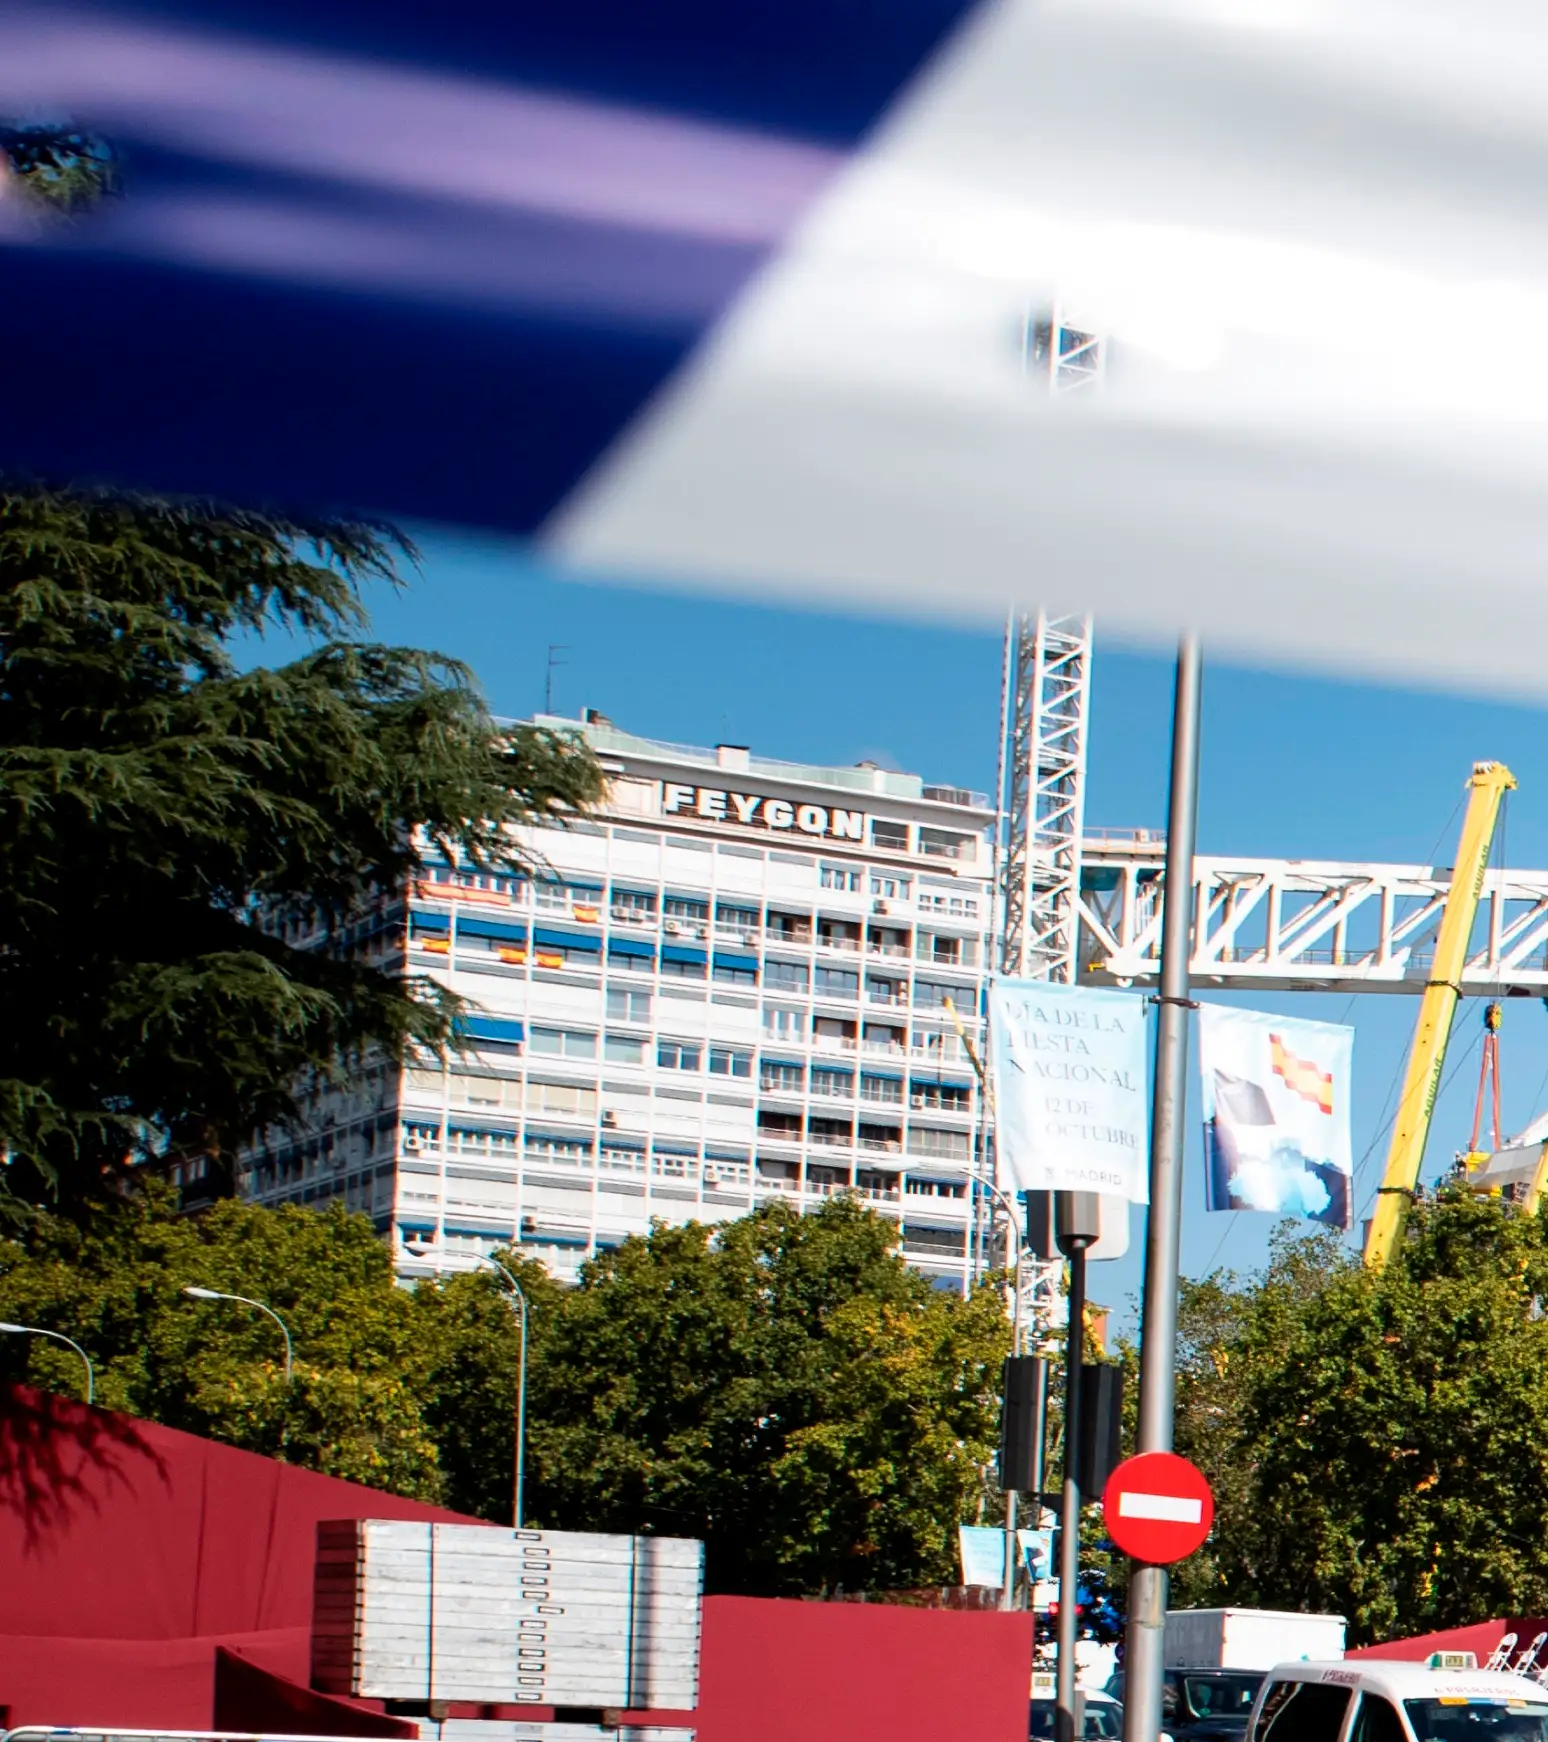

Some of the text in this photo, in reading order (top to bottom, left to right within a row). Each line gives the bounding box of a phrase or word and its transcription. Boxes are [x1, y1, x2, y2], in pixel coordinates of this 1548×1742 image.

[665, 783, 863, 840] FEYGON
[1056, 1008, 1090, 1030] DE
[1094, 1011, 1126, 1033] LA
[1009, 1058, 1137, 1092] NACIONAL
[1045, 1124, 1140, 1150] OCTUBRE
[1065, 1169, 1123, 1186] MADRID
